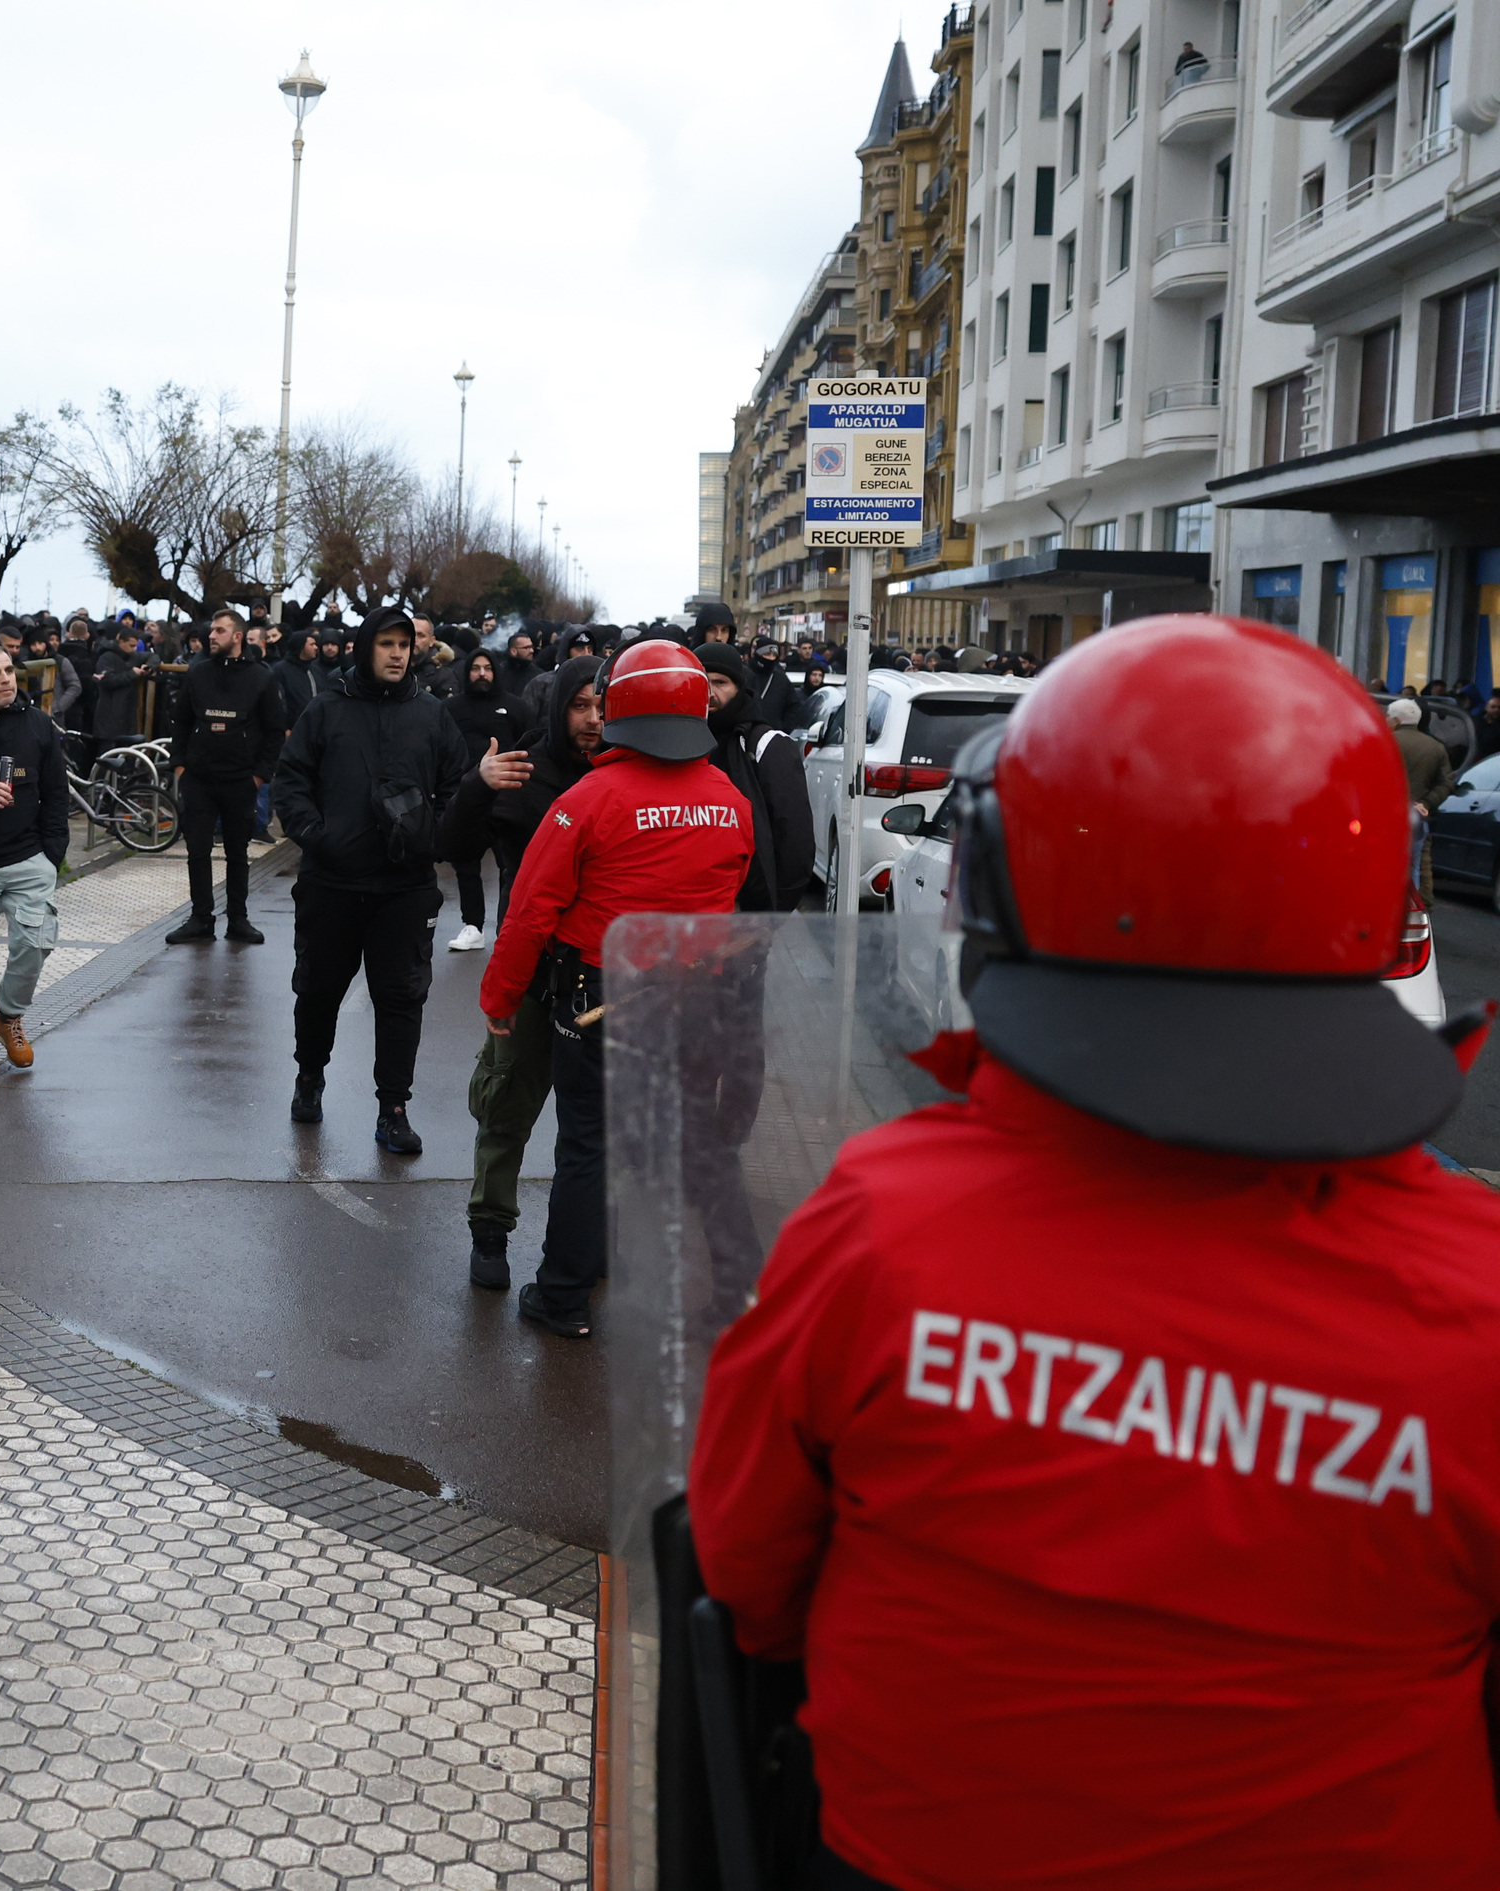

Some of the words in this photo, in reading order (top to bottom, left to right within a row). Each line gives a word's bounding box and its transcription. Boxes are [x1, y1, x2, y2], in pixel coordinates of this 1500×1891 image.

[817, 381, 921, 397] GOGORATU
[828, 405, 906, 415] APARKALDI
[834, 417, 898, 428] MUGATUA
[875, 439, 907, 449] GUNE
[865, 453, 911, 462] BEREZIA
[873, 467, 907, 476] ZONA
[860, 480, 913, 490] ESPECIAL
[813, 499, 915, 508] ESTACIONAMIENTO
[838, 511, 889, 521] LIMITADO
[811, 530, 905, 545] RECUERDE
[635, 805, 739, 830] ERTZAINTZA
[904, 1309, 1433, 1517] ERTZAINTZA
